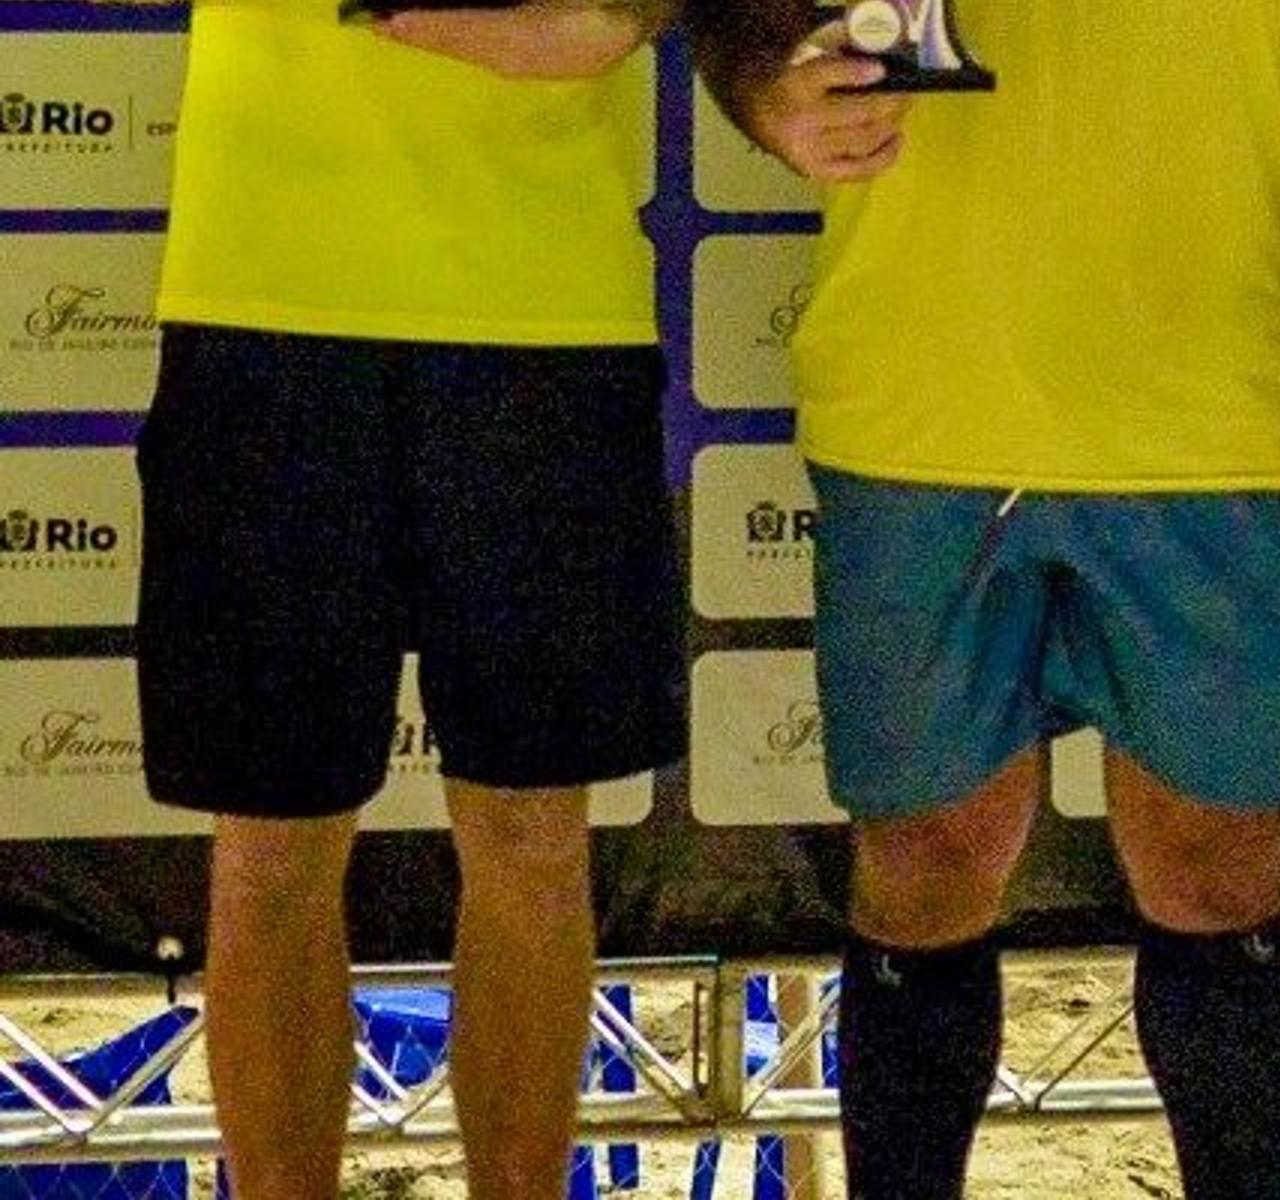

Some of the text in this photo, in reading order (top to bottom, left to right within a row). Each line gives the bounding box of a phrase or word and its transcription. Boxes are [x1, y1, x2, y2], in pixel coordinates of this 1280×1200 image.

[42, 102, 114, 136] Rio
[26, 283, 157, 339] Fairmo
[46, 519, 118, 552] Rio
